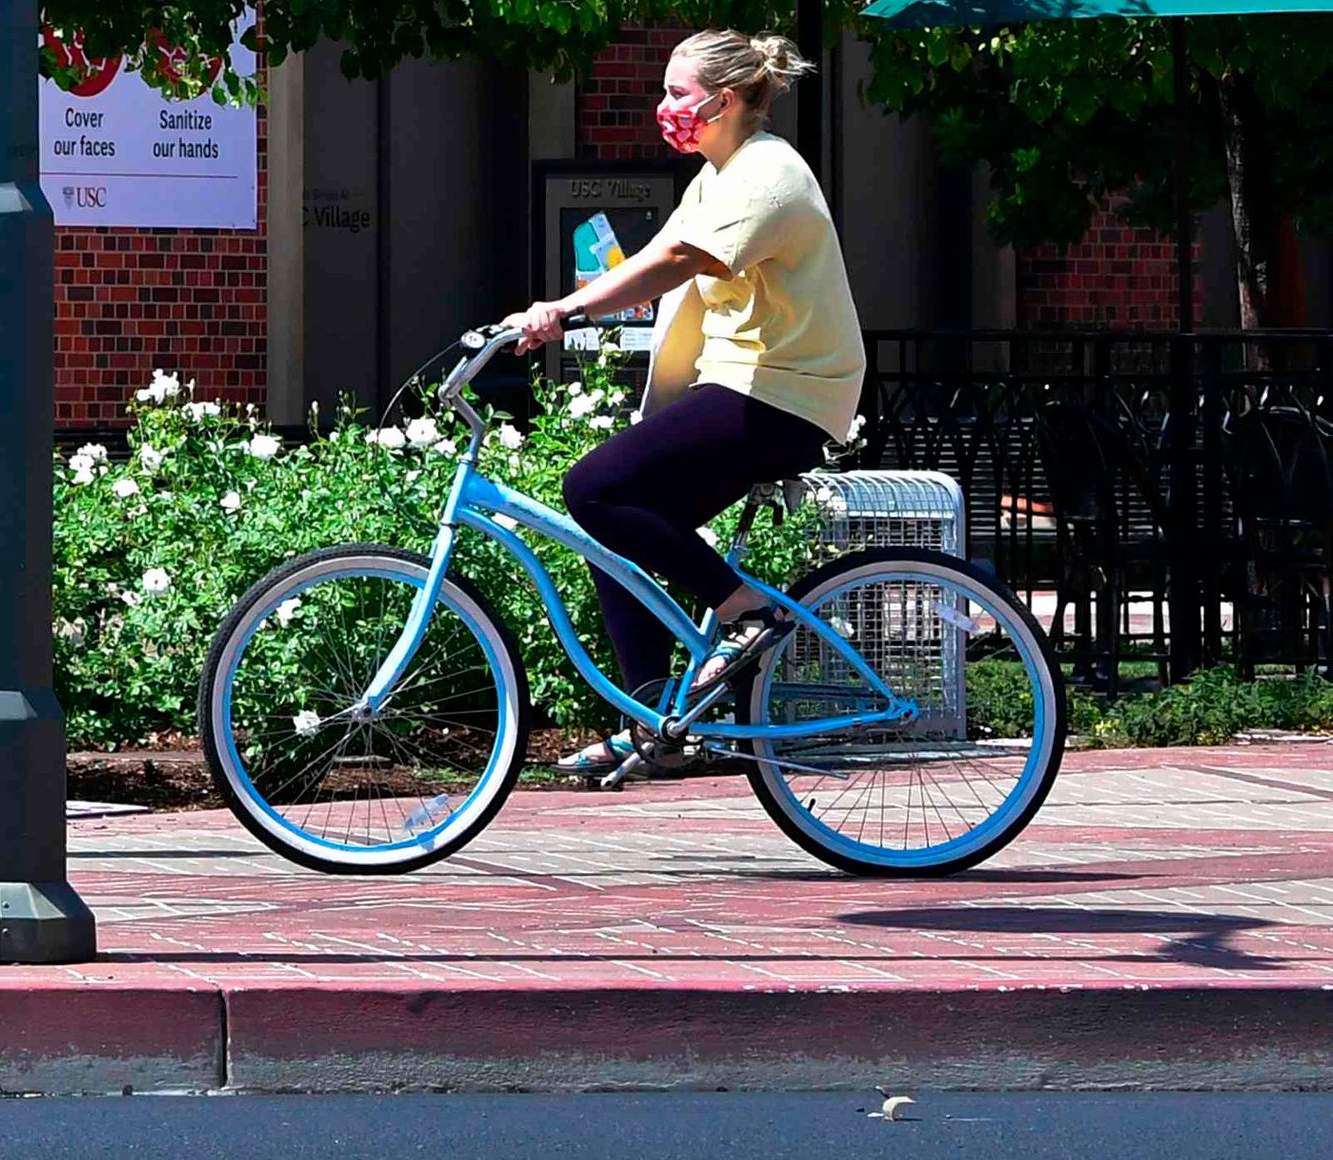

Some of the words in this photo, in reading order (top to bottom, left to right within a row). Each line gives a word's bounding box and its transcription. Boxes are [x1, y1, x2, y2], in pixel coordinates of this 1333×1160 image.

[64, 107, 104, 129] Cover
[159, 108, 213, 131] Sanitize
[53, 140, 76, 156] our
[80, 135, 116, 157] faces
[152, 142, 175, 158] our
[178, 137, 219, 159] hands
[76, 186, 108, 209] USC
[314, 205, 370, 233] Village
